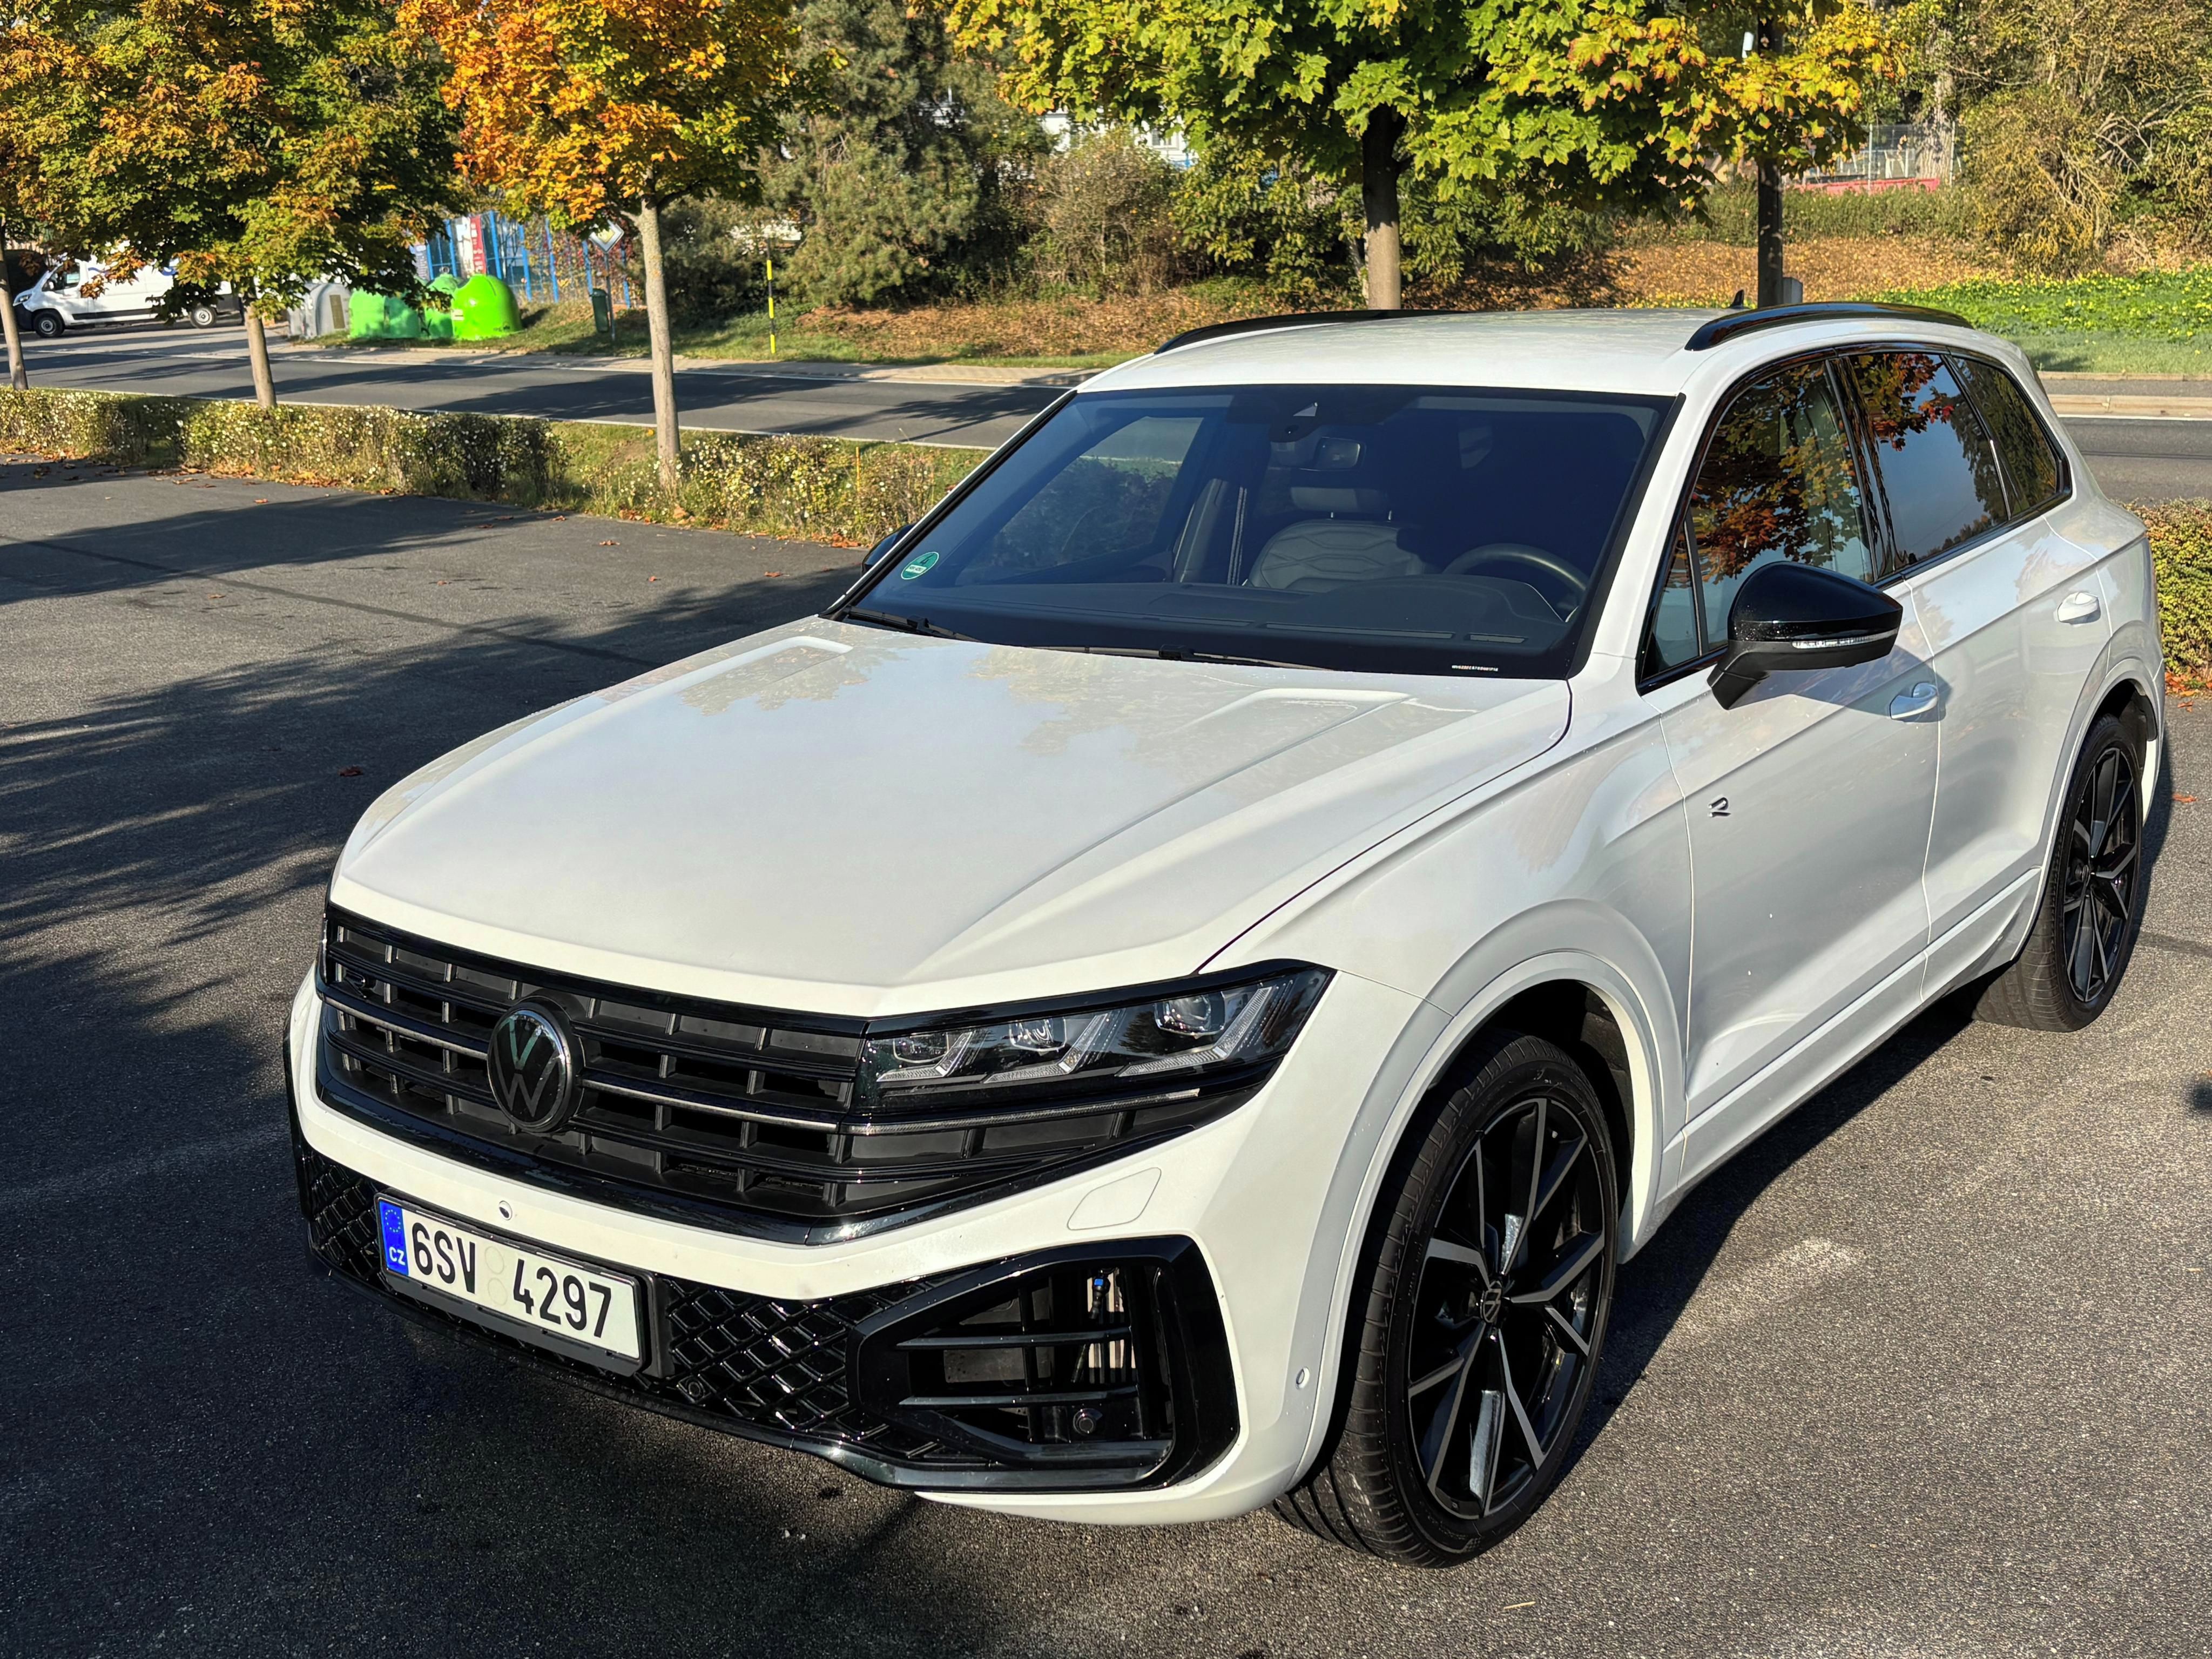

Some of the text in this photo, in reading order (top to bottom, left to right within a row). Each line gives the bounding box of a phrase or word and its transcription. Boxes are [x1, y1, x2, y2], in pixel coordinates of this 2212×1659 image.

[389, 1246, 406, 1266] CZ
[412, 1223, 611, 1338] 6SV 4297
